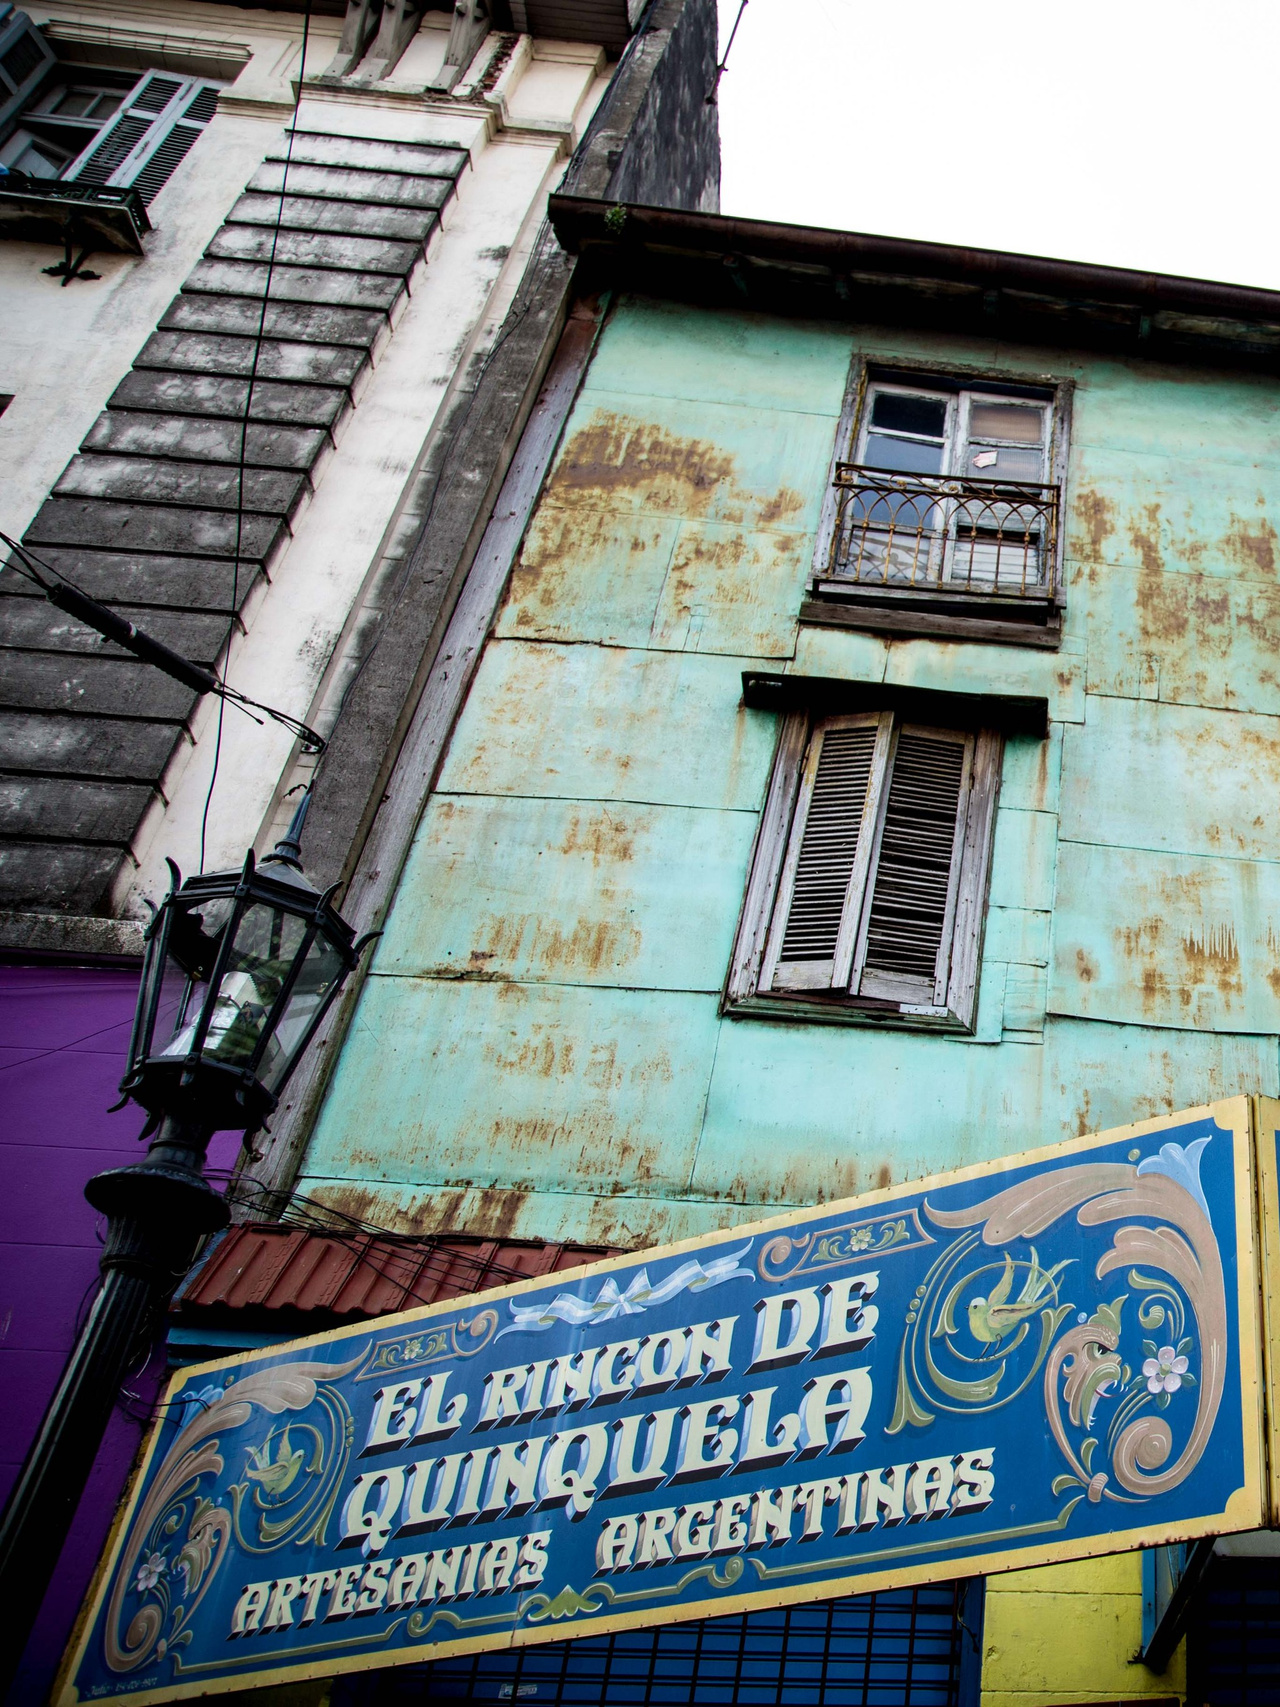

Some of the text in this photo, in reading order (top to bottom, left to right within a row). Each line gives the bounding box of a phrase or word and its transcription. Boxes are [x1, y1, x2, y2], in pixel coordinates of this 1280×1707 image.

[356, 1270, 881, 1459] EL RINCON DE
[226, 1447, 996, 1641] ARTESANIAS ARGENTINAS
[333, 1366, 872, 1559] QUINQUELA
